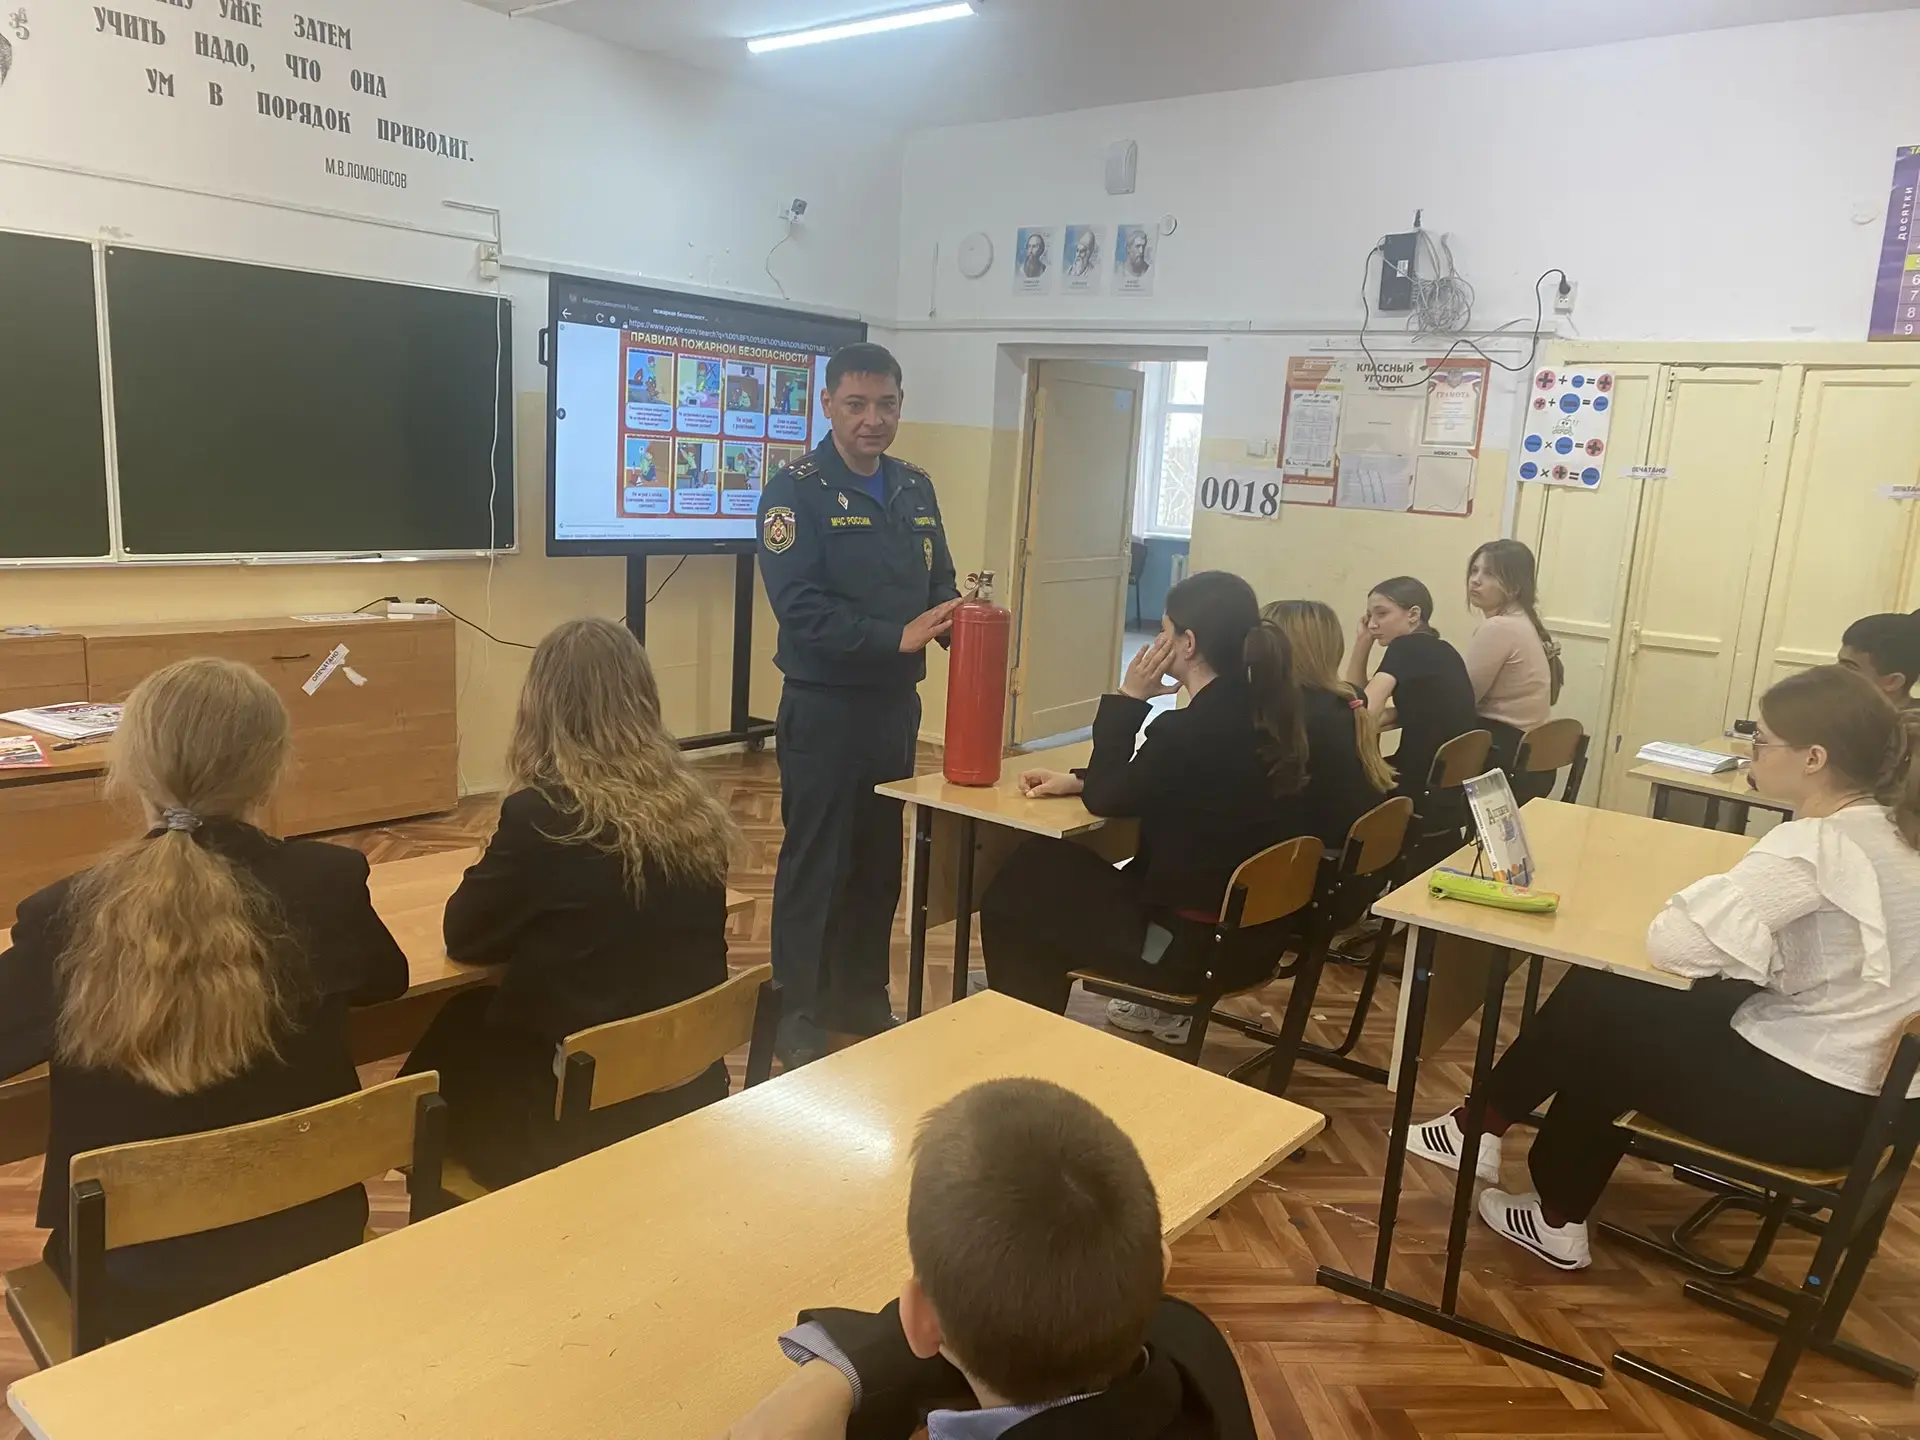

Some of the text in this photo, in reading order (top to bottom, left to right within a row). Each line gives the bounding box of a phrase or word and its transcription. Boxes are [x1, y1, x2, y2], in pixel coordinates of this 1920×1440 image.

[219, 0, 352, 50] УЖЕ ЗАТЕМ
[93, 6, 387, 98] УЧИТЬ НАДО, ЧТО ОНА
[145, 68, 474, 162] УМ В ПОРЯДОК ПРИВОДИТ.
[325, 157, 407, 189] М.В.ЛОМОНОСОВ
[1909, 289, 1919, 302] 7
[1906, 306, 1916, 319] 8
[1904, 323, 1914, 336] 9
[630, 331, 679, 347] ПРАВИЛА
[738, 345, 808, 363] БЕЗОПАСНОСТИ
[1356, 362, 1414, 373] КЛАССНЫЙ
[1364, 373, 1404, 384] УГОЛОК
[1436, 391, 1470, 399] ГРАМОТА
[1201, 476, 1280, 516] 0018
[830, 516, 846, 527] МЧС
